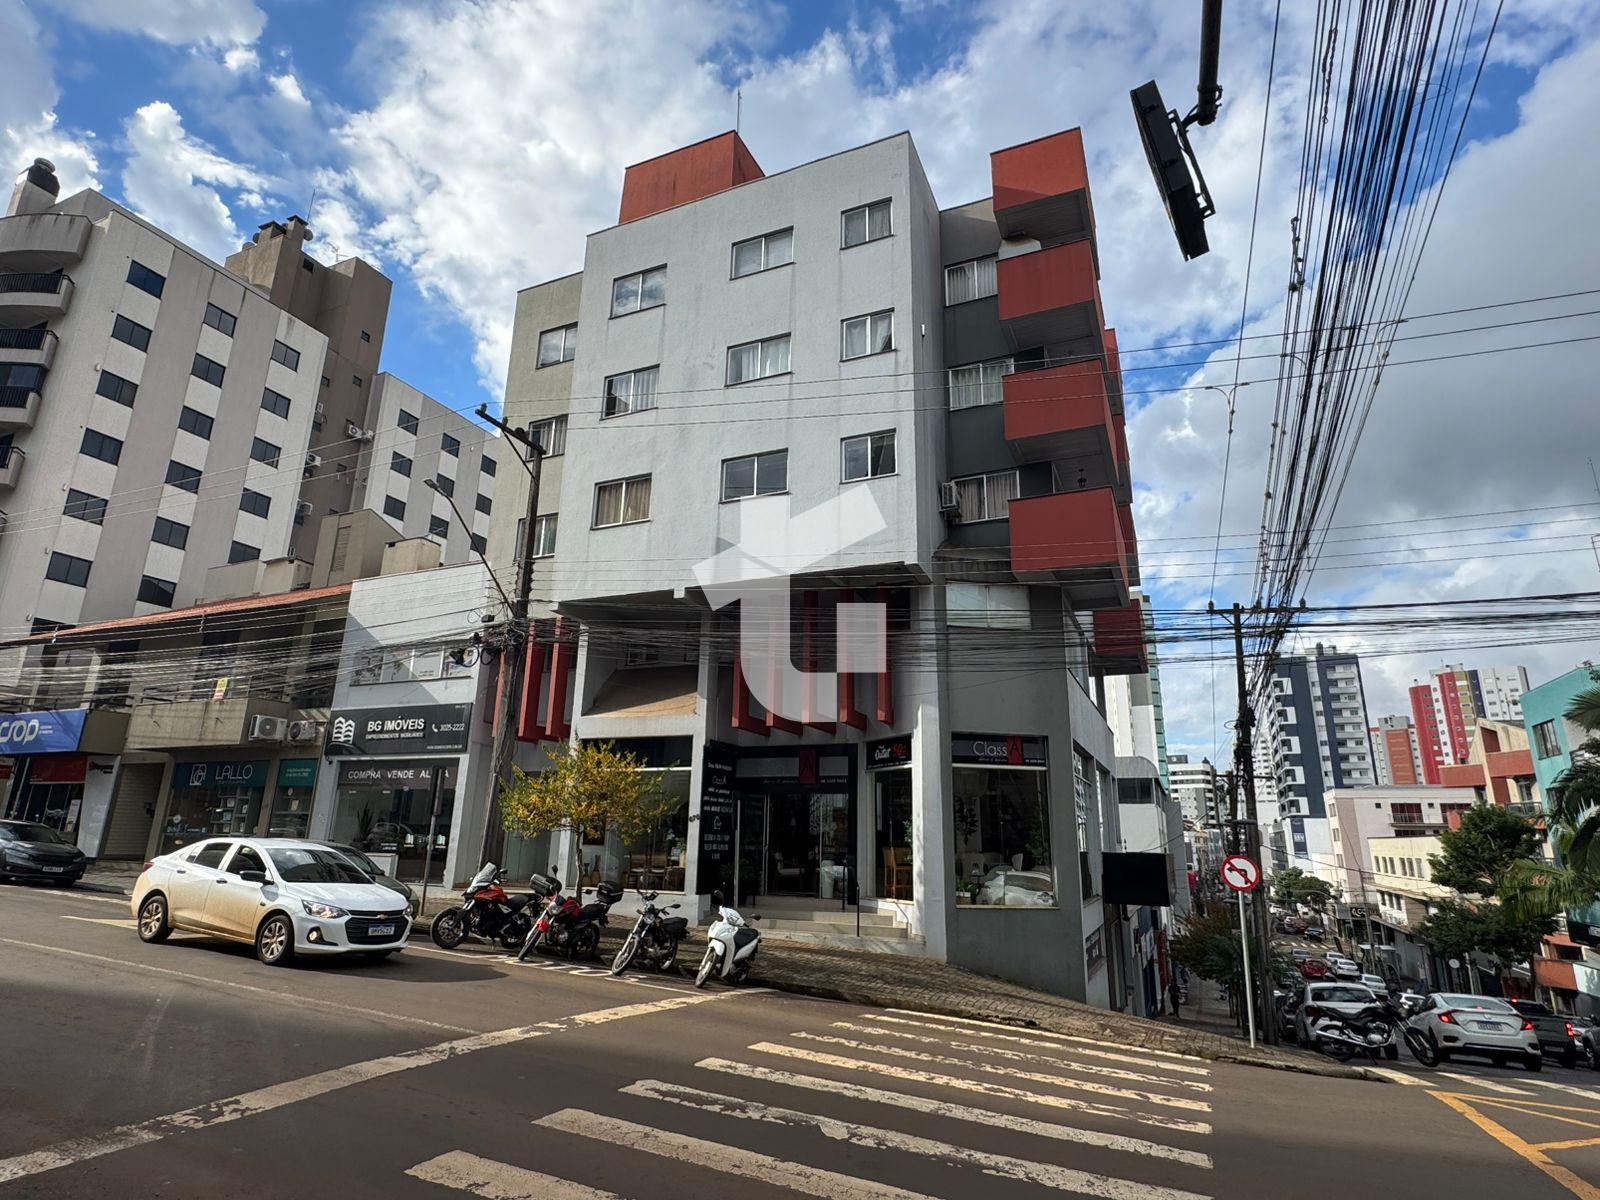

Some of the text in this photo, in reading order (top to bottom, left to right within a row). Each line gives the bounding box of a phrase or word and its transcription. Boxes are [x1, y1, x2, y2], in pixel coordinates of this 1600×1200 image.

[367, 715, 425, 732] BG IMÓVEIS
[973, 740, 1007, 757] Class
[215, 764, 253, 780] LALLO
[348, 769, 449, 779] COMPRA VENDE ALA
